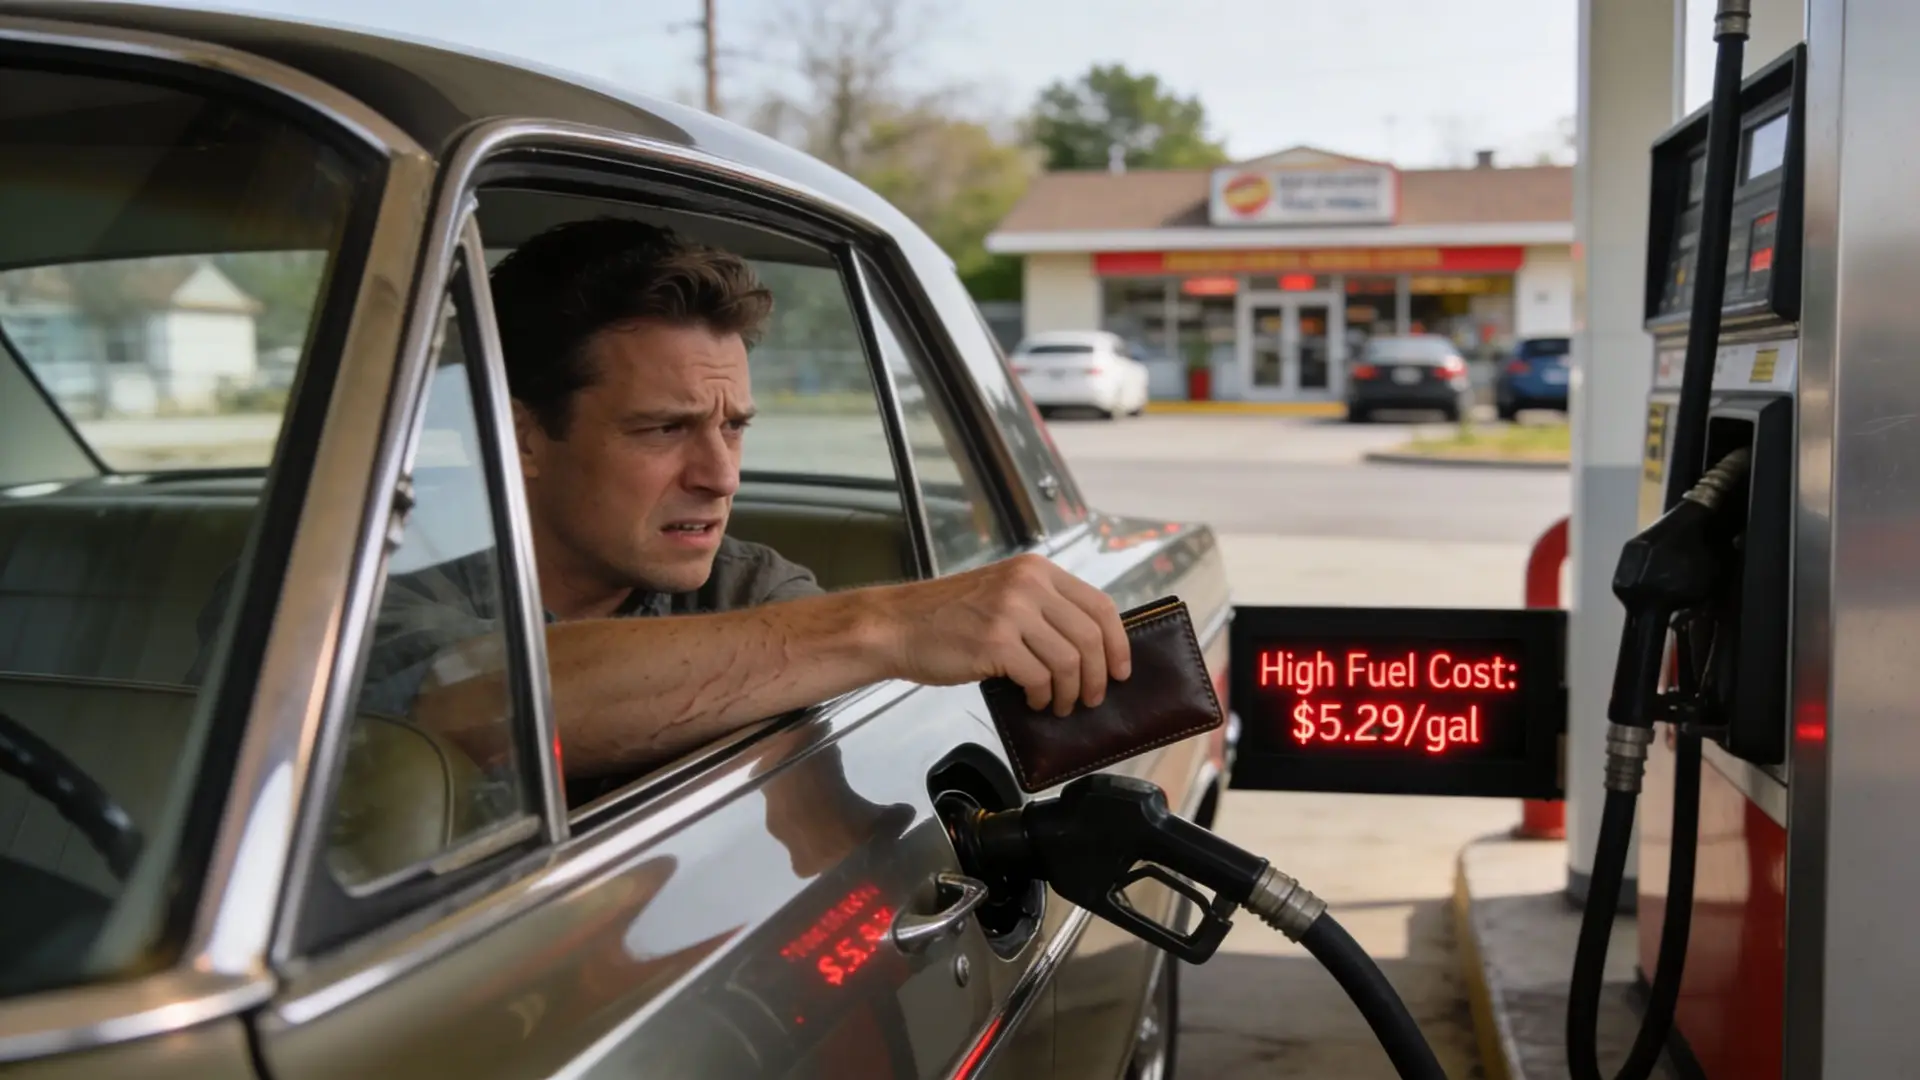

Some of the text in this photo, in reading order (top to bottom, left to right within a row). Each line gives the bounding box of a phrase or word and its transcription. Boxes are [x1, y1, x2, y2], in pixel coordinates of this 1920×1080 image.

[1260, 650, 1517, 695] High Fuel Cost:
[1292, 698, 1479, 753] $5.29/gal
